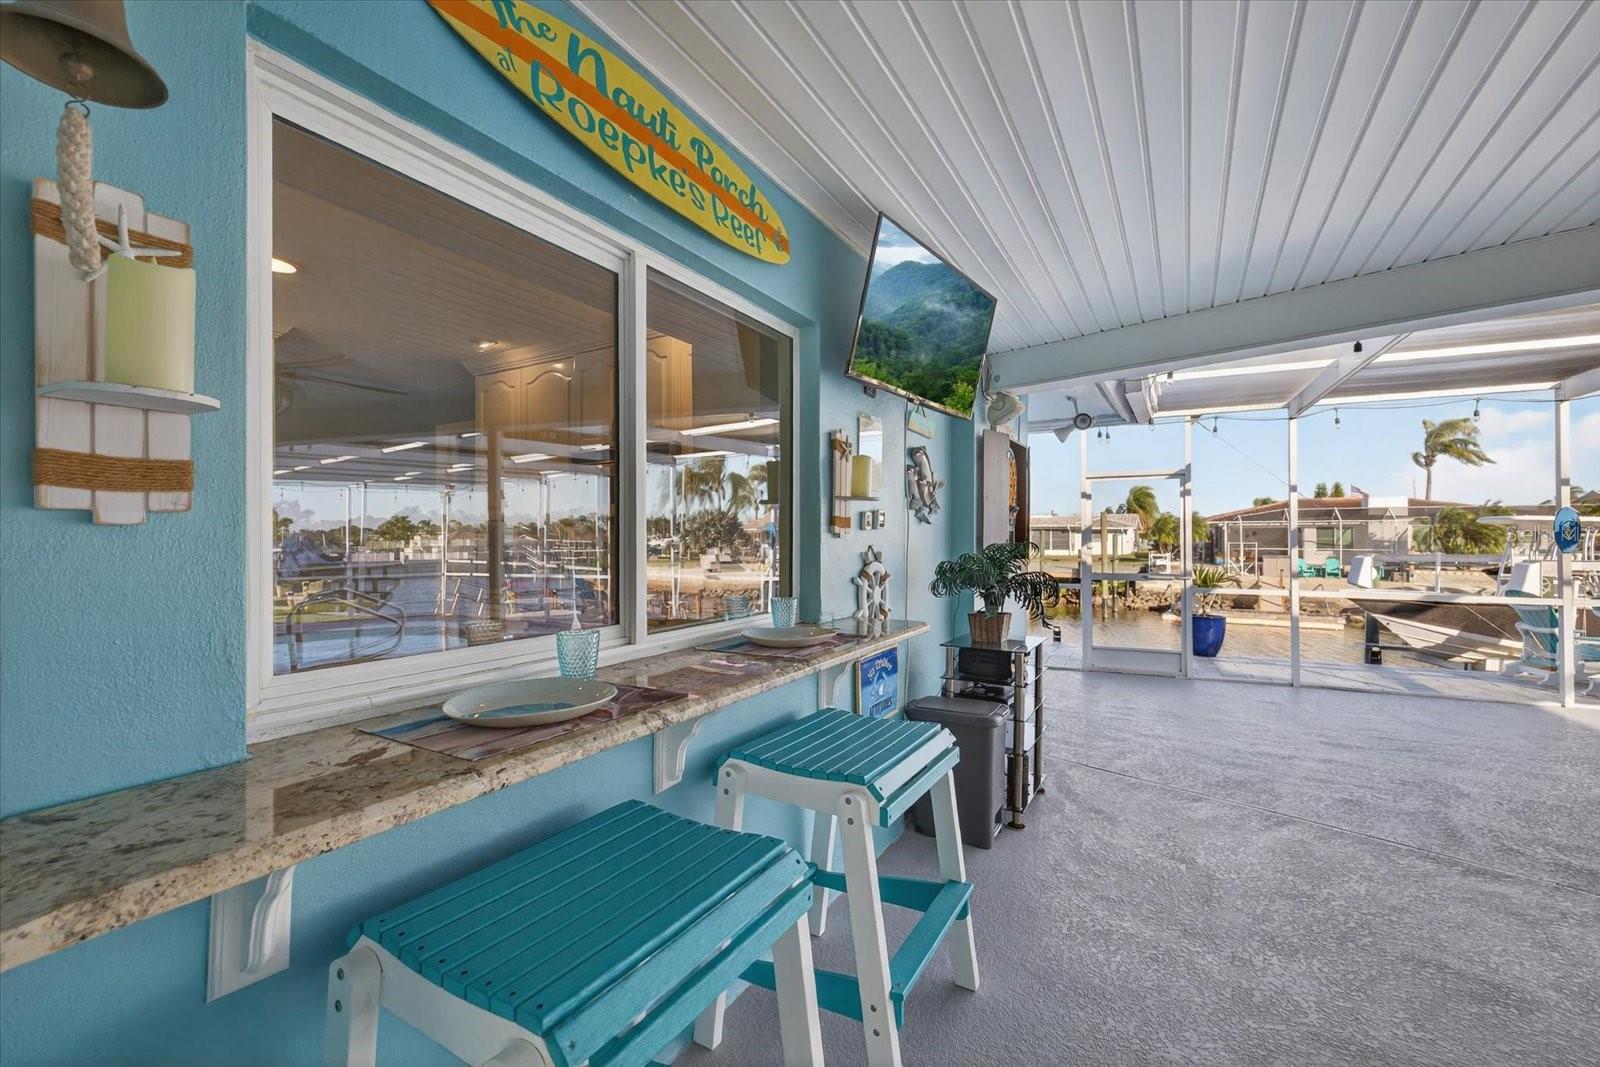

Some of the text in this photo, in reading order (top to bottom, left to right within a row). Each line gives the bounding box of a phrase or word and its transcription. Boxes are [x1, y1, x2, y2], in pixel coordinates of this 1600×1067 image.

[482, 0, 768, 222] The Nauti Porch
[497, 47, 516, 73] at
[711, 192, 767, 254] Reef
